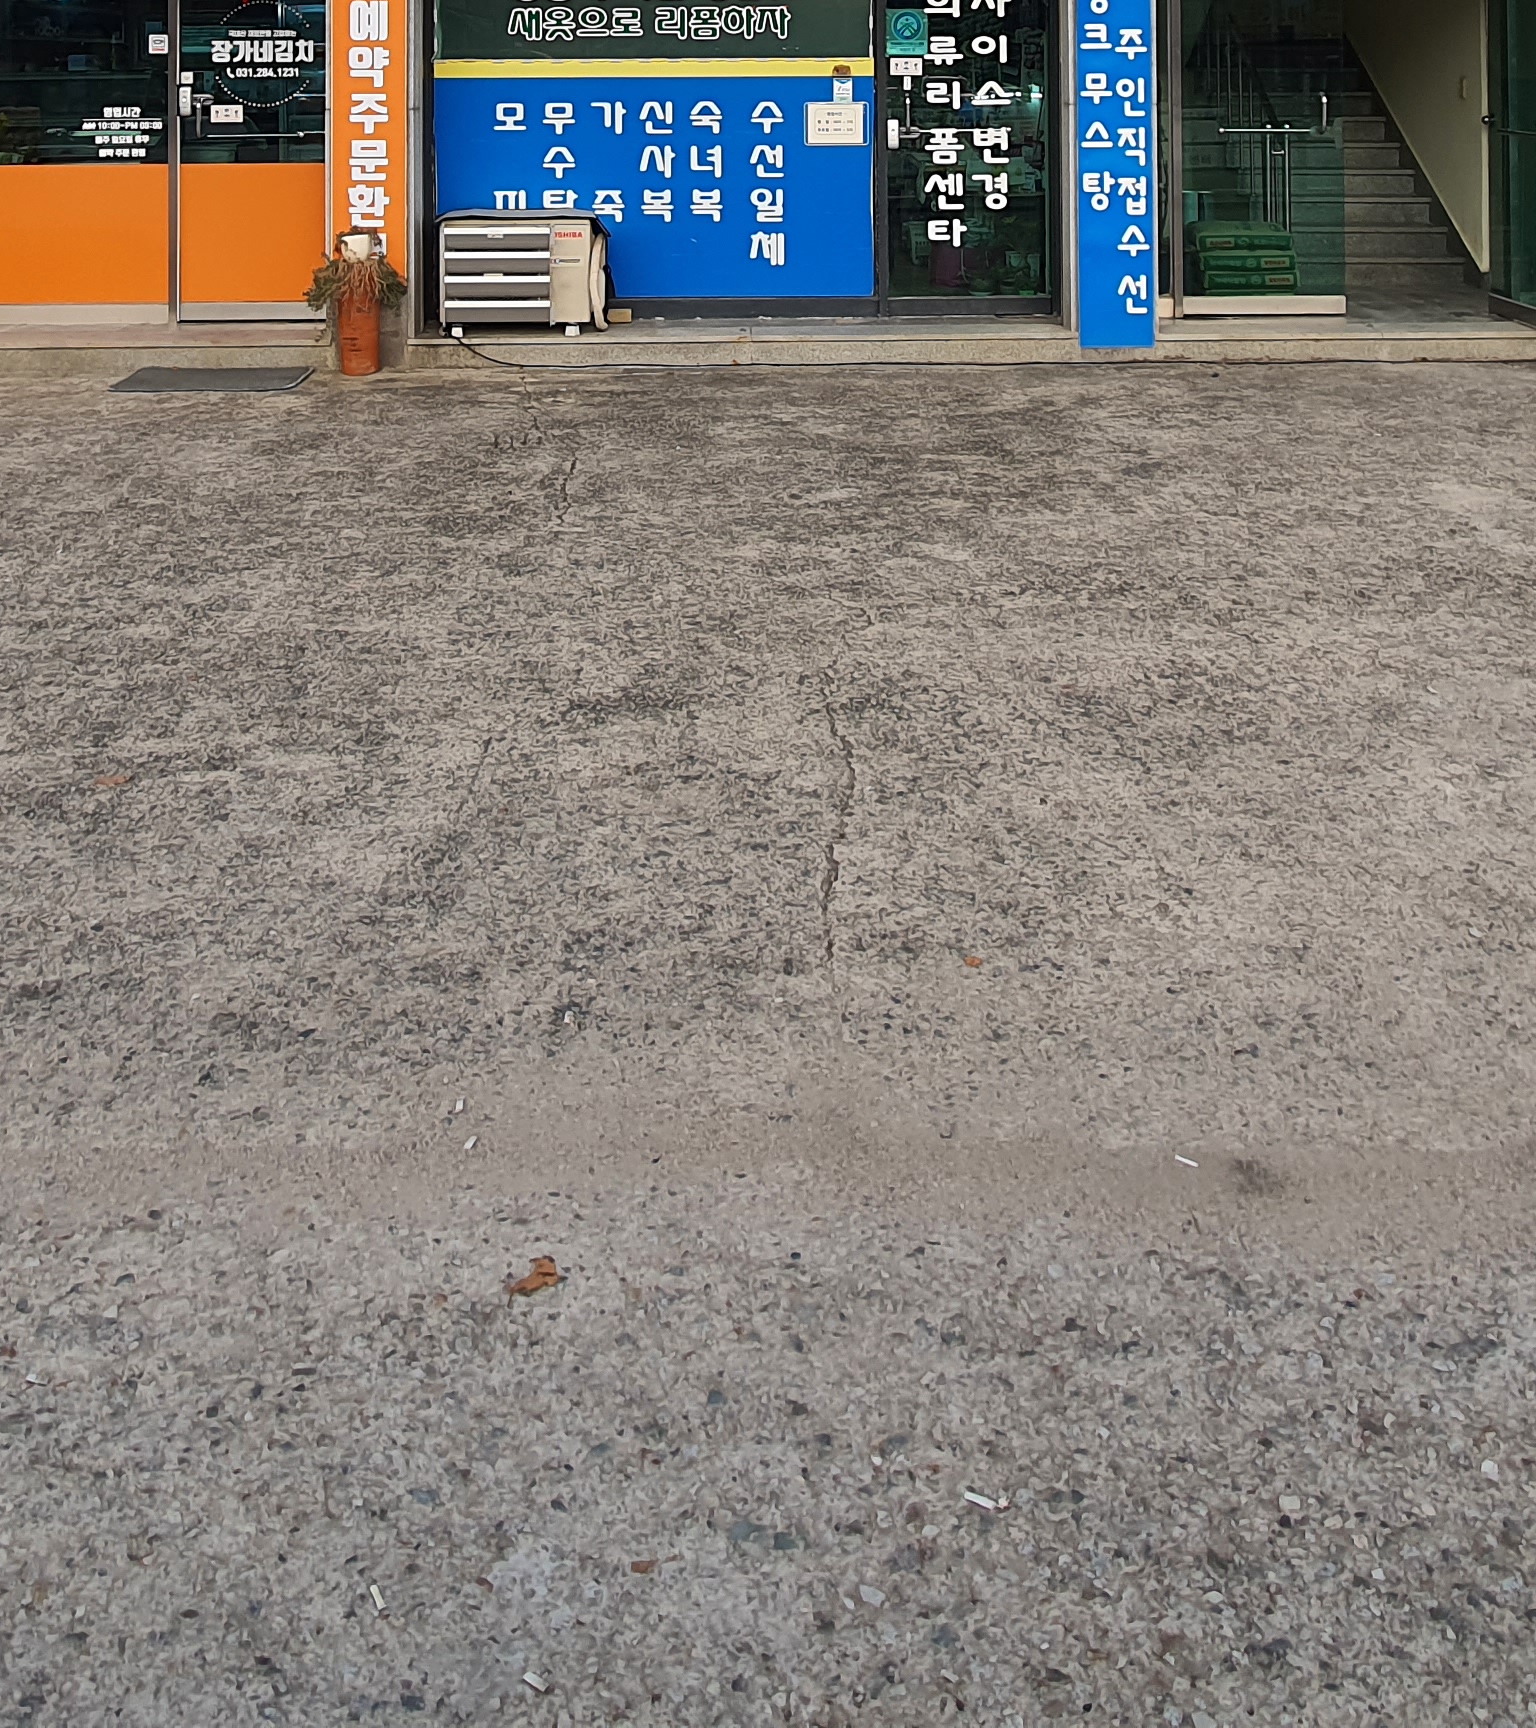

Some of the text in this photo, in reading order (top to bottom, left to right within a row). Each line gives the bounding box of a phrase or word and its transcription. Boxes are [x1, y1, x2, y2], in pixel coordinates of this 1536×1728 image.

[507, 5, 791, 41] 새옷으로 리폼하자
[211, 39, 314, 63] 장가네김치
[348, 0, 390, 258] 예약주문환
